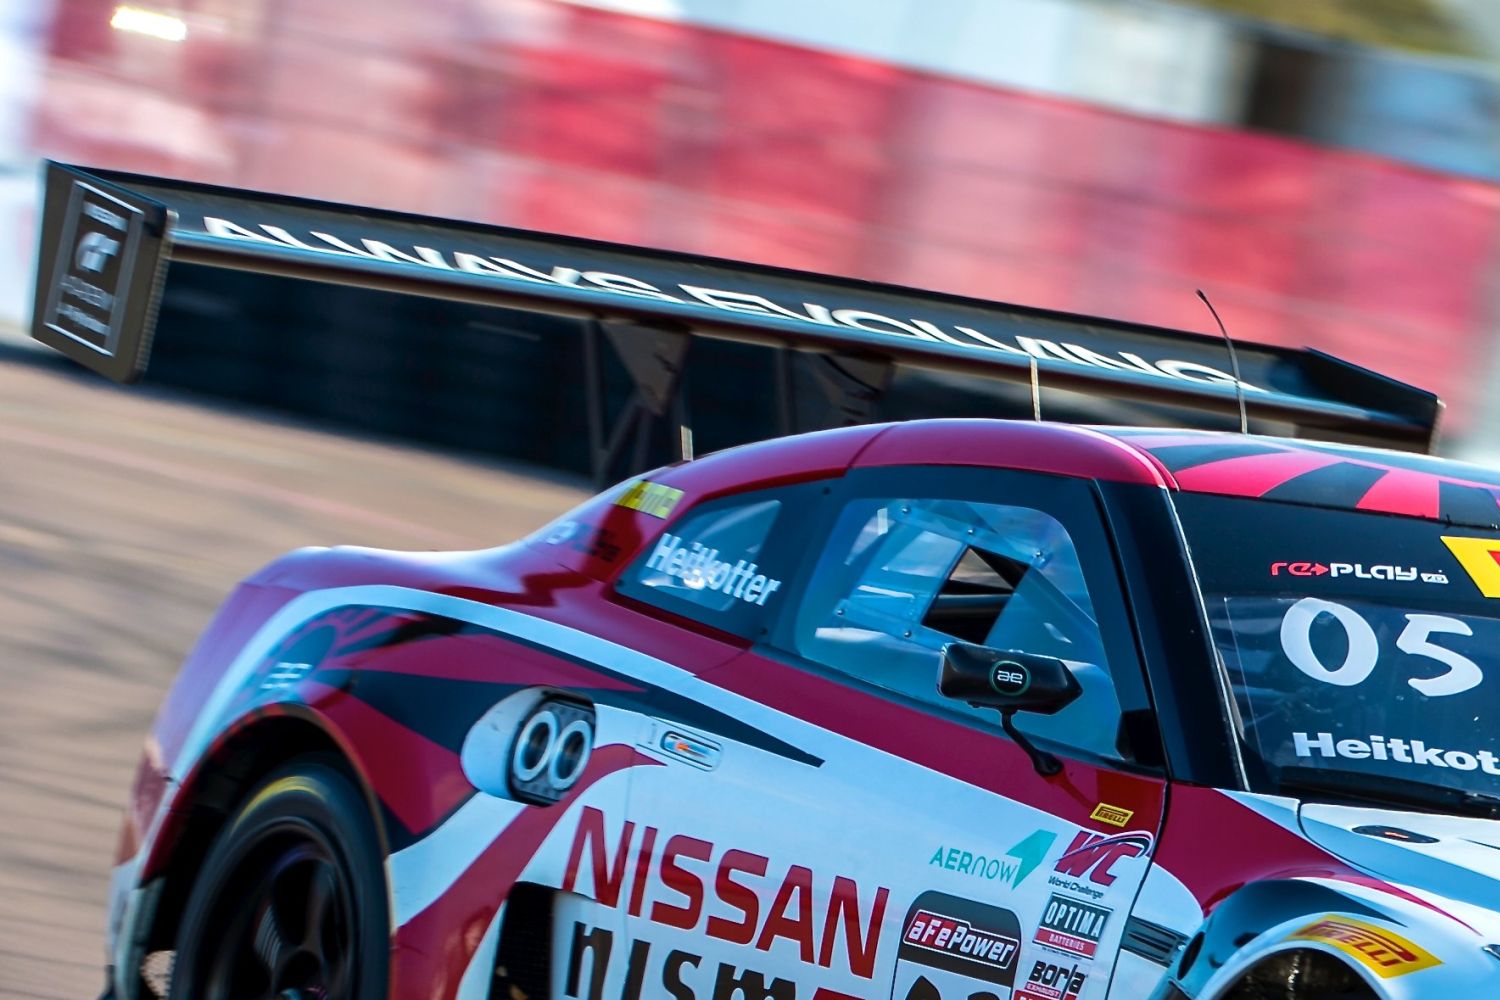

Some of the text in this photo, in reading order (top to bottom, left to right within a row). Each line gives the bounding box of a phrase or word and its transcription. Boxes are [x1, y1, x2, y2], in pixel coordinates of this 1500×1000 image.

[645, 532, 781, 606] Heitkotter
[1280, 597, 1484, 697] 05
[563, 805, 890, 980] NISSAN
[1044, 901, 1105, 938] OPTIMA
